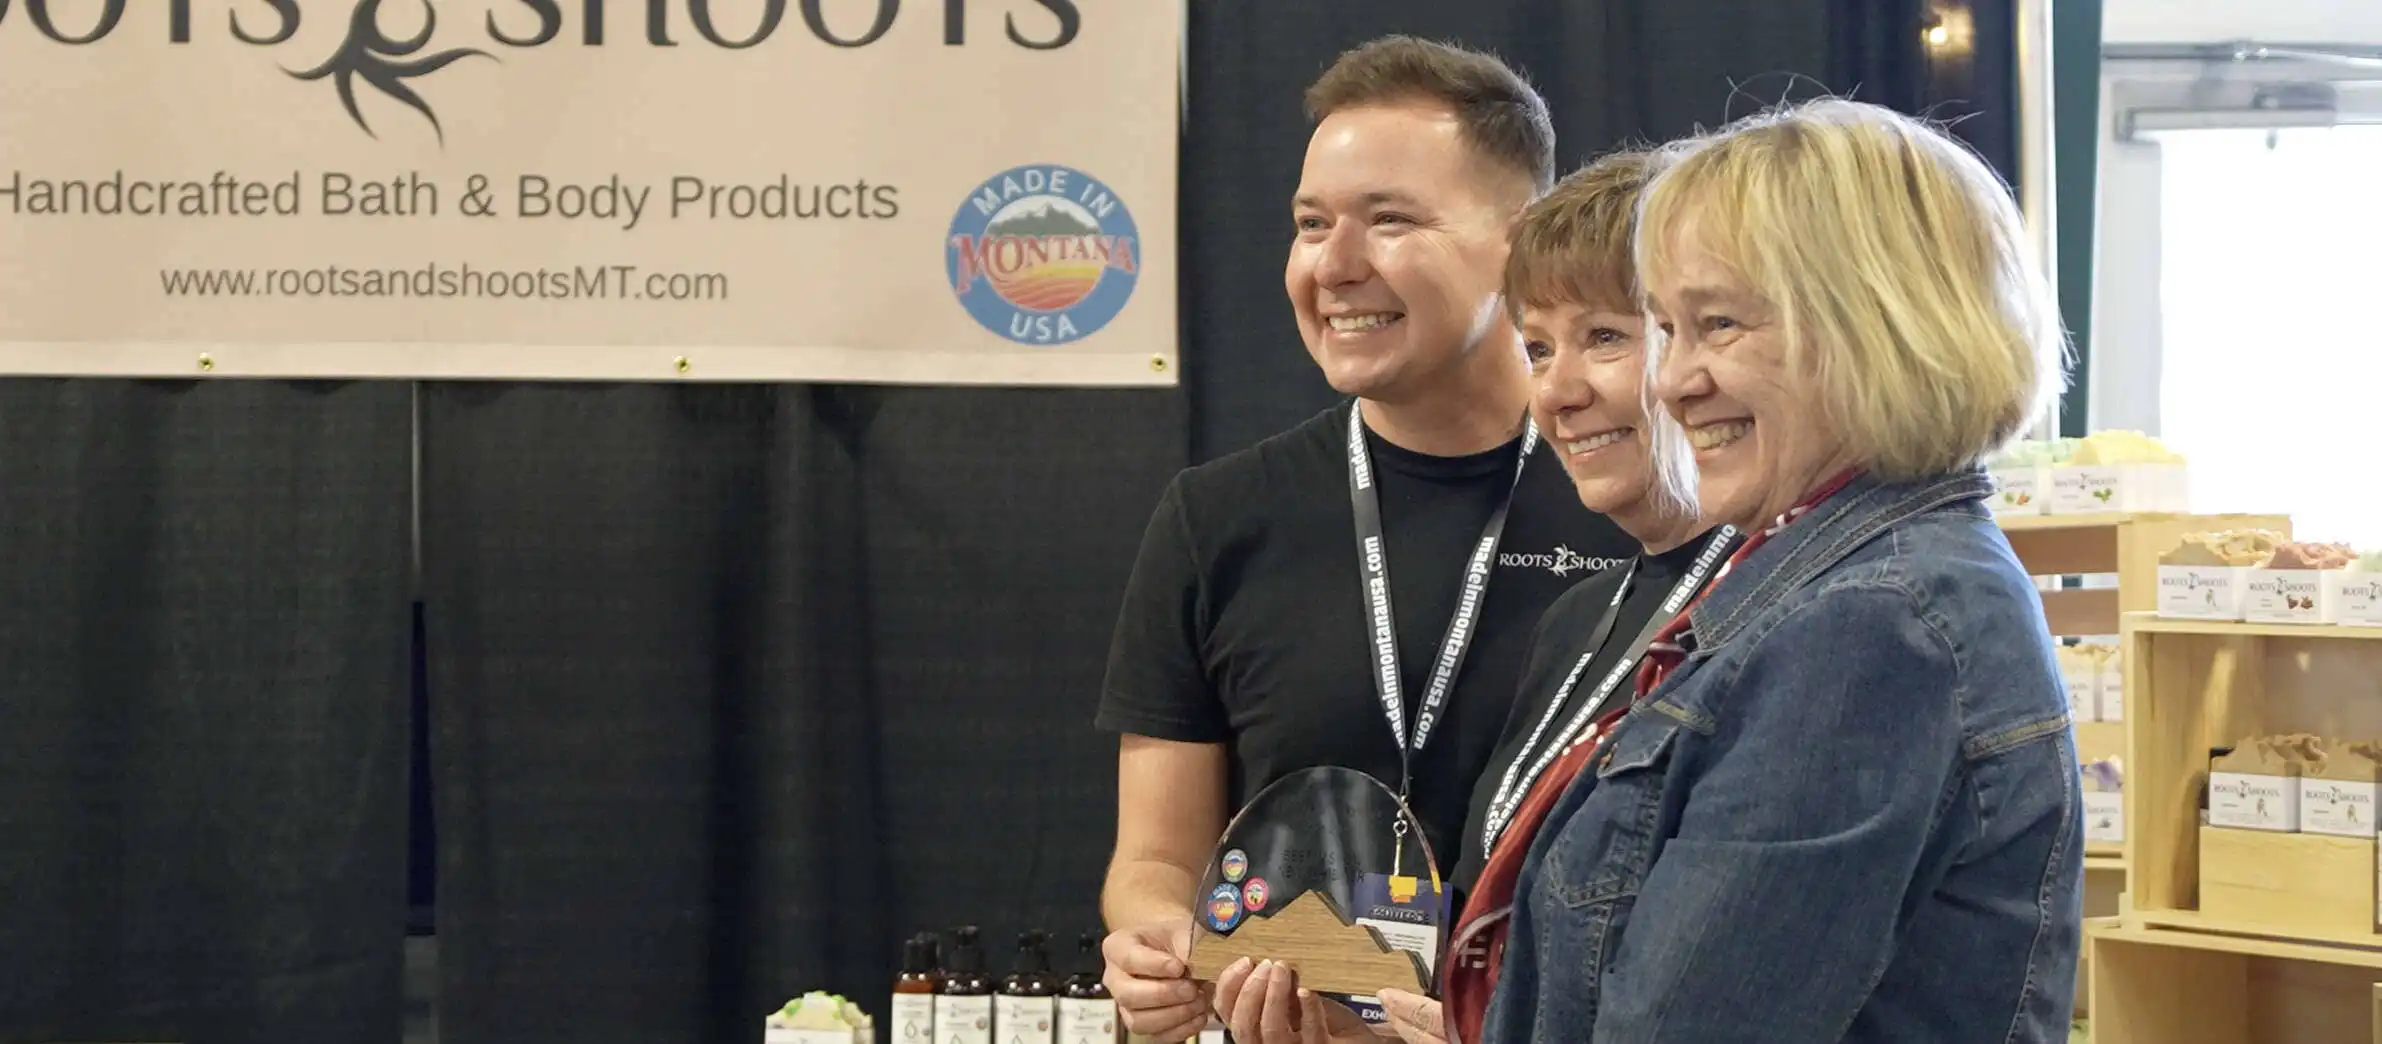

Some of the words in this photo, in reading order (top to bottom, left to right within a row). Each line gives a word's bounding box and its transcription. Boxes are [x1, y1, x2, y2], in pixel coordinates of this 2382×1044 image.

[322, 171, 438, 216] Bath
[459, 173, 497, 217] &
[518, 173, 651, 230] Body
[671, 173, 899, 220] Products
[972, 168, 1069, 216] MADE
[1079, 183, 1116, 217] IN
[160, 262, 728, 300] www.rootsandshootsMT.com
[952, 233, 1138, 295] MONTANA
[1010, 312, 1078, 342] USA
[1499, 553, 1553, 568] ROOTS
[1570, 555, 1625, 571] SHOO
[1663, 523, 1738, 614] madeinmo
[1413, 535, 1495, 751] madeinmontanausa.com
